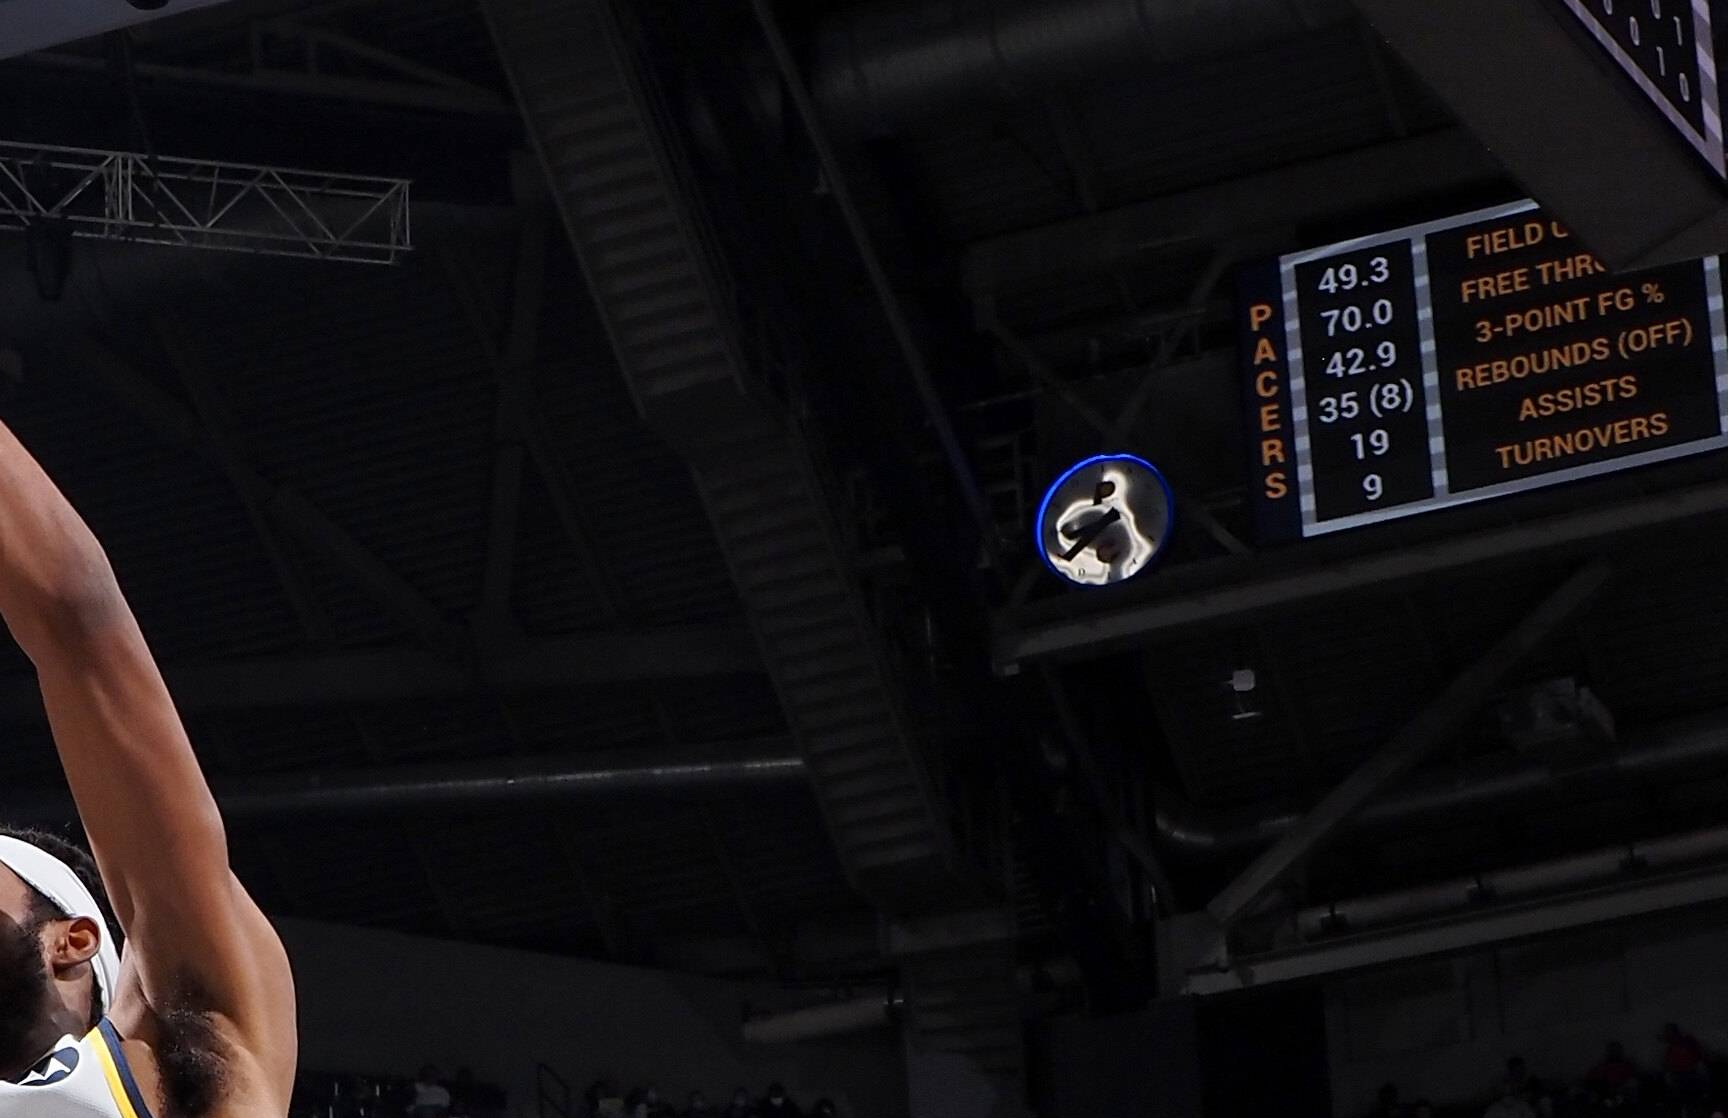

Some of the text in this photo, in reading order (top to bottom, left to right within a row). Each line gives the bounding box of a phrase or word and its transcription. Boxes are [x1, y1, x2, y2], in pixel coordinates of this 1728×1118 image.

[1466, 222, 1544, 259] FIELD
[1318, 256, 1389, 293] 49.3
[1461, 268, 1530, 303] FREE
[1320, 299, 1393, 336] 70.0
[1475, 283, 1665, 343] 3-POINT FG %
[1325, 341, 1396, 378] 42.9
[1456, 318, 1693, 391] REBOUNDS (OFF)
[1319, 378, 1414, 423] 35 (8)
[1518, 375, 1638, 422] ASSISTS
[1350, 429, 1390, 460] 19
[1496, 412, 1669, 469] TURNOVERS
[1362, 473, 1383, 500] 9
